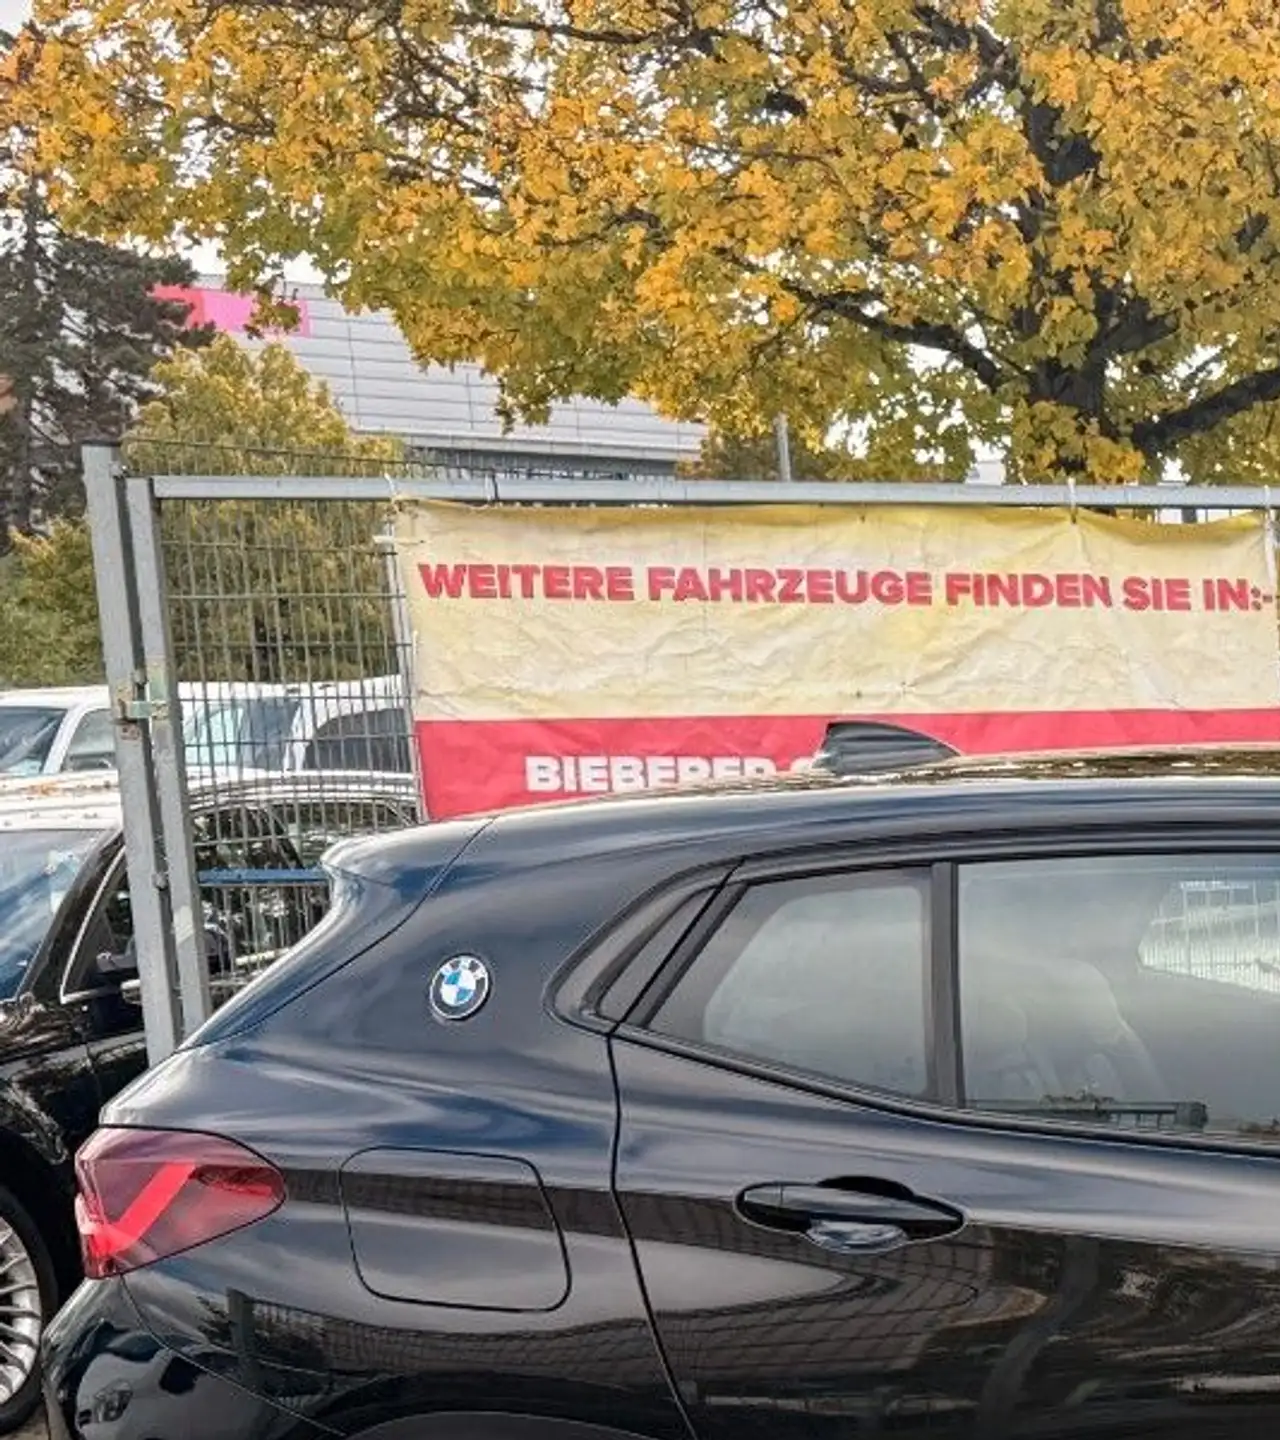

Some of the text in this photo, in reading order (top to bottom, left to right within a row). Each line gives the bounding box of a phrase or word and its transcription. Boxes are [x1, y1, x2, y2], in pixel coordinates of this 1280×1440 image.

[418, 563, 635, 601] WEITERE
[647, 566, 933, 605] FAHRZEUGE
[945, 572, 1112, 607] FINDEN
[1123, 576, 1191, 611] SIE
